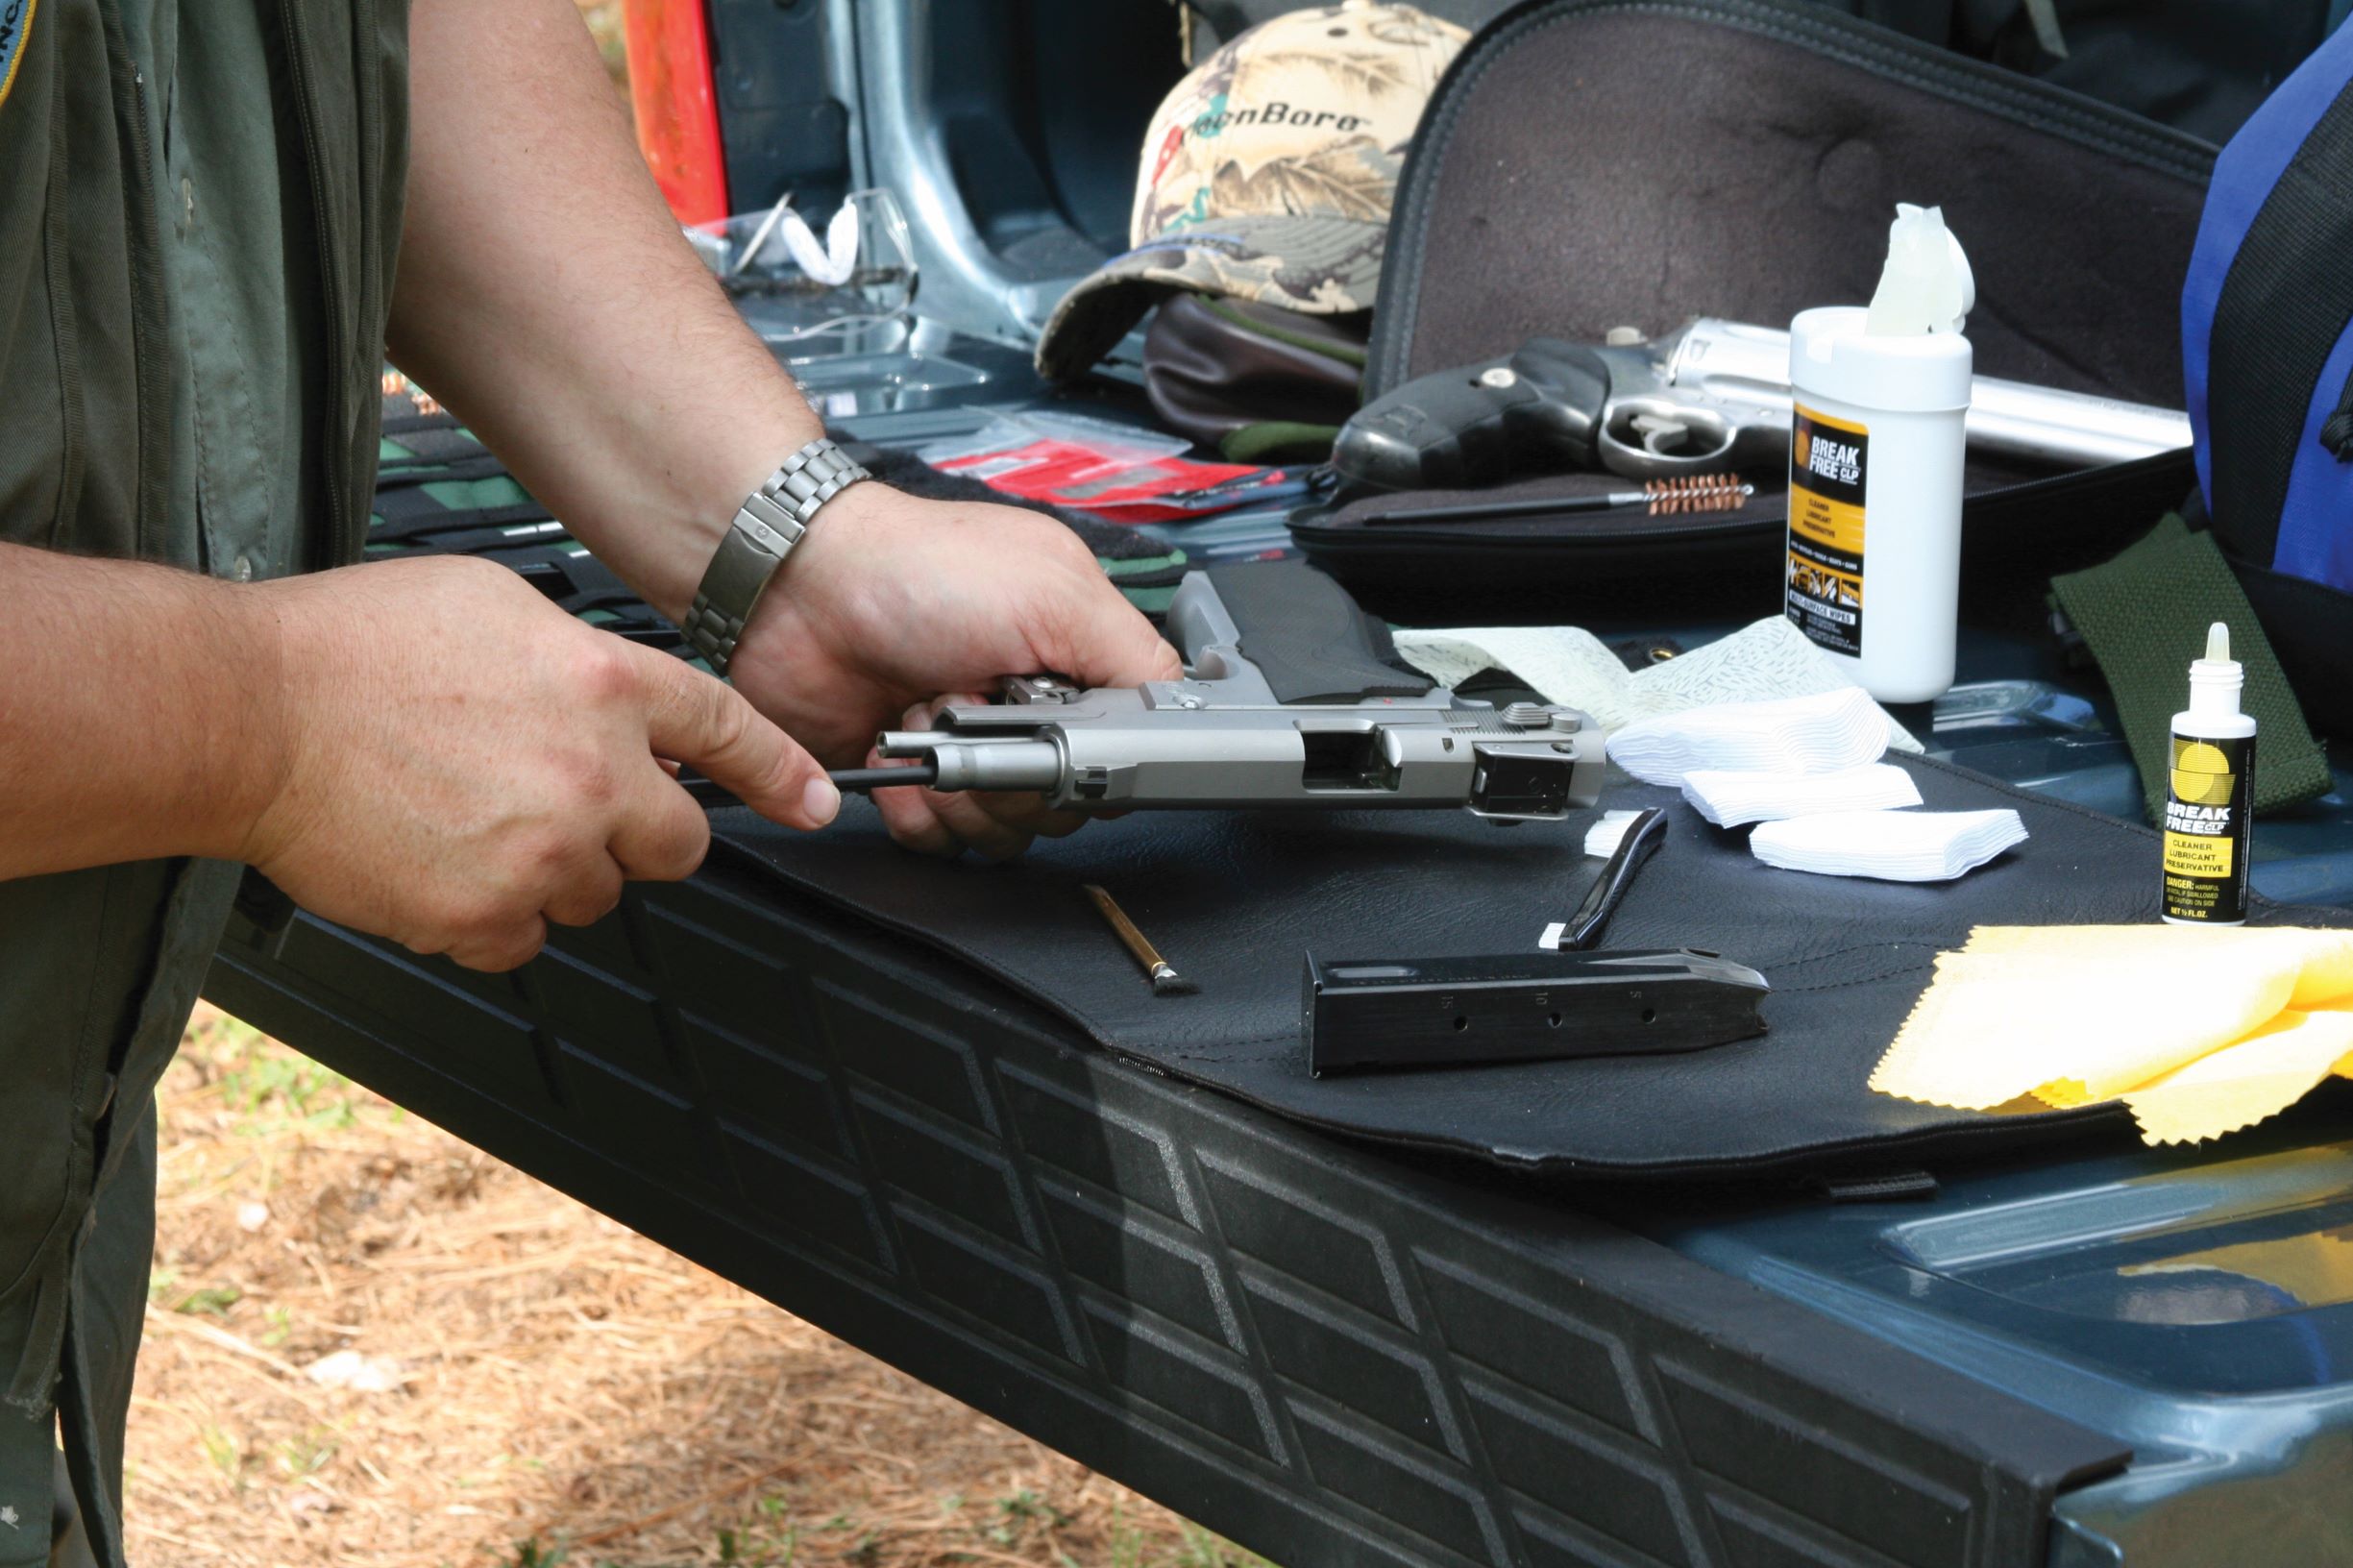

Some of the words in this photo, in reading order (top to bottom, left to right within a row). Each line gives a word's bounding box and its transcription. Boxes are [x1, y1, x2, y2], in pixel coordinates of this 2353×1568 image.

[1812, 435, 1859, 466] BREAK
[1809, 453, 1839, 479] FREE
[1840, 467, 1859, 480] CLP
[1828, 610, 1851, 624] WIPES
[2167, 801, 2231, 821] BREAK
[2166, 815, 2204, 834] FREE
[2172, 839, 2213, 850] CLEANER
[2169, 849, 2217, 861] LUBRICANT
[2166, 859, 2223, 872] PRESERVATIVE
[1535, 992, 1549, 1006] 10
